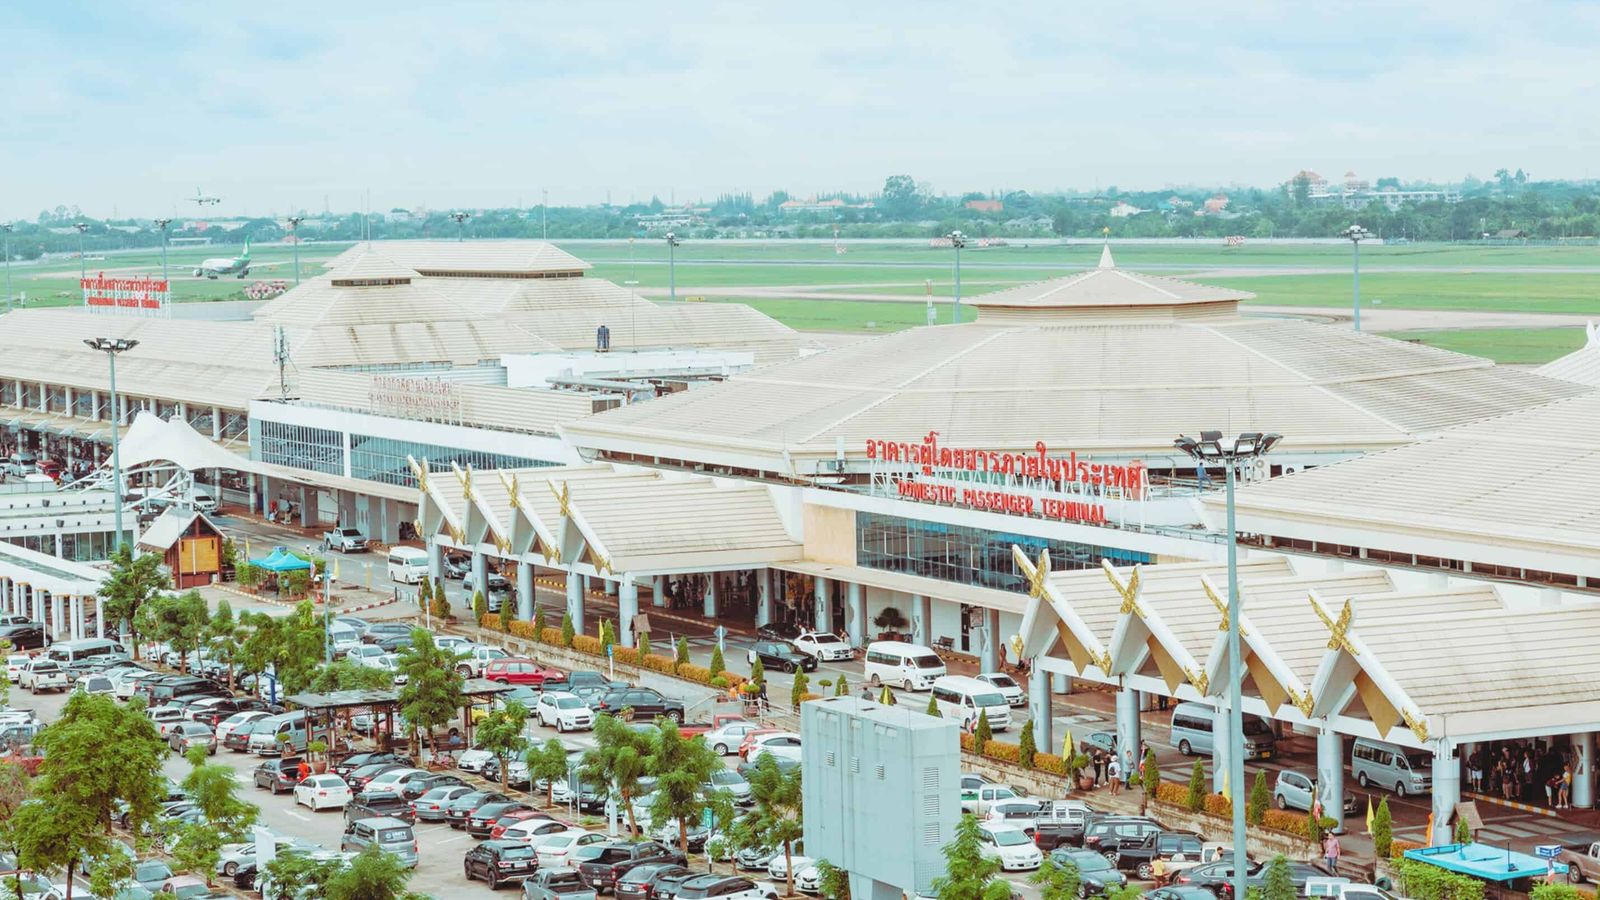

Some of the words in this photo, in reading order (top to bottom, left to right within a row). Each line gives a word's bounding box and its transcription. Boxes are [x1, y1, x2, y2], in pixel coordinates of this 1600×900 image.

[866, 430, 1142, 489] อาคารผู้โดยสารภายในประเทศ
[897, 479, 957, 504] DOMESTIC
[962, 488, 1034, 514] PASSENGER
[1040, 497, 1107, 525] TERMINAL
